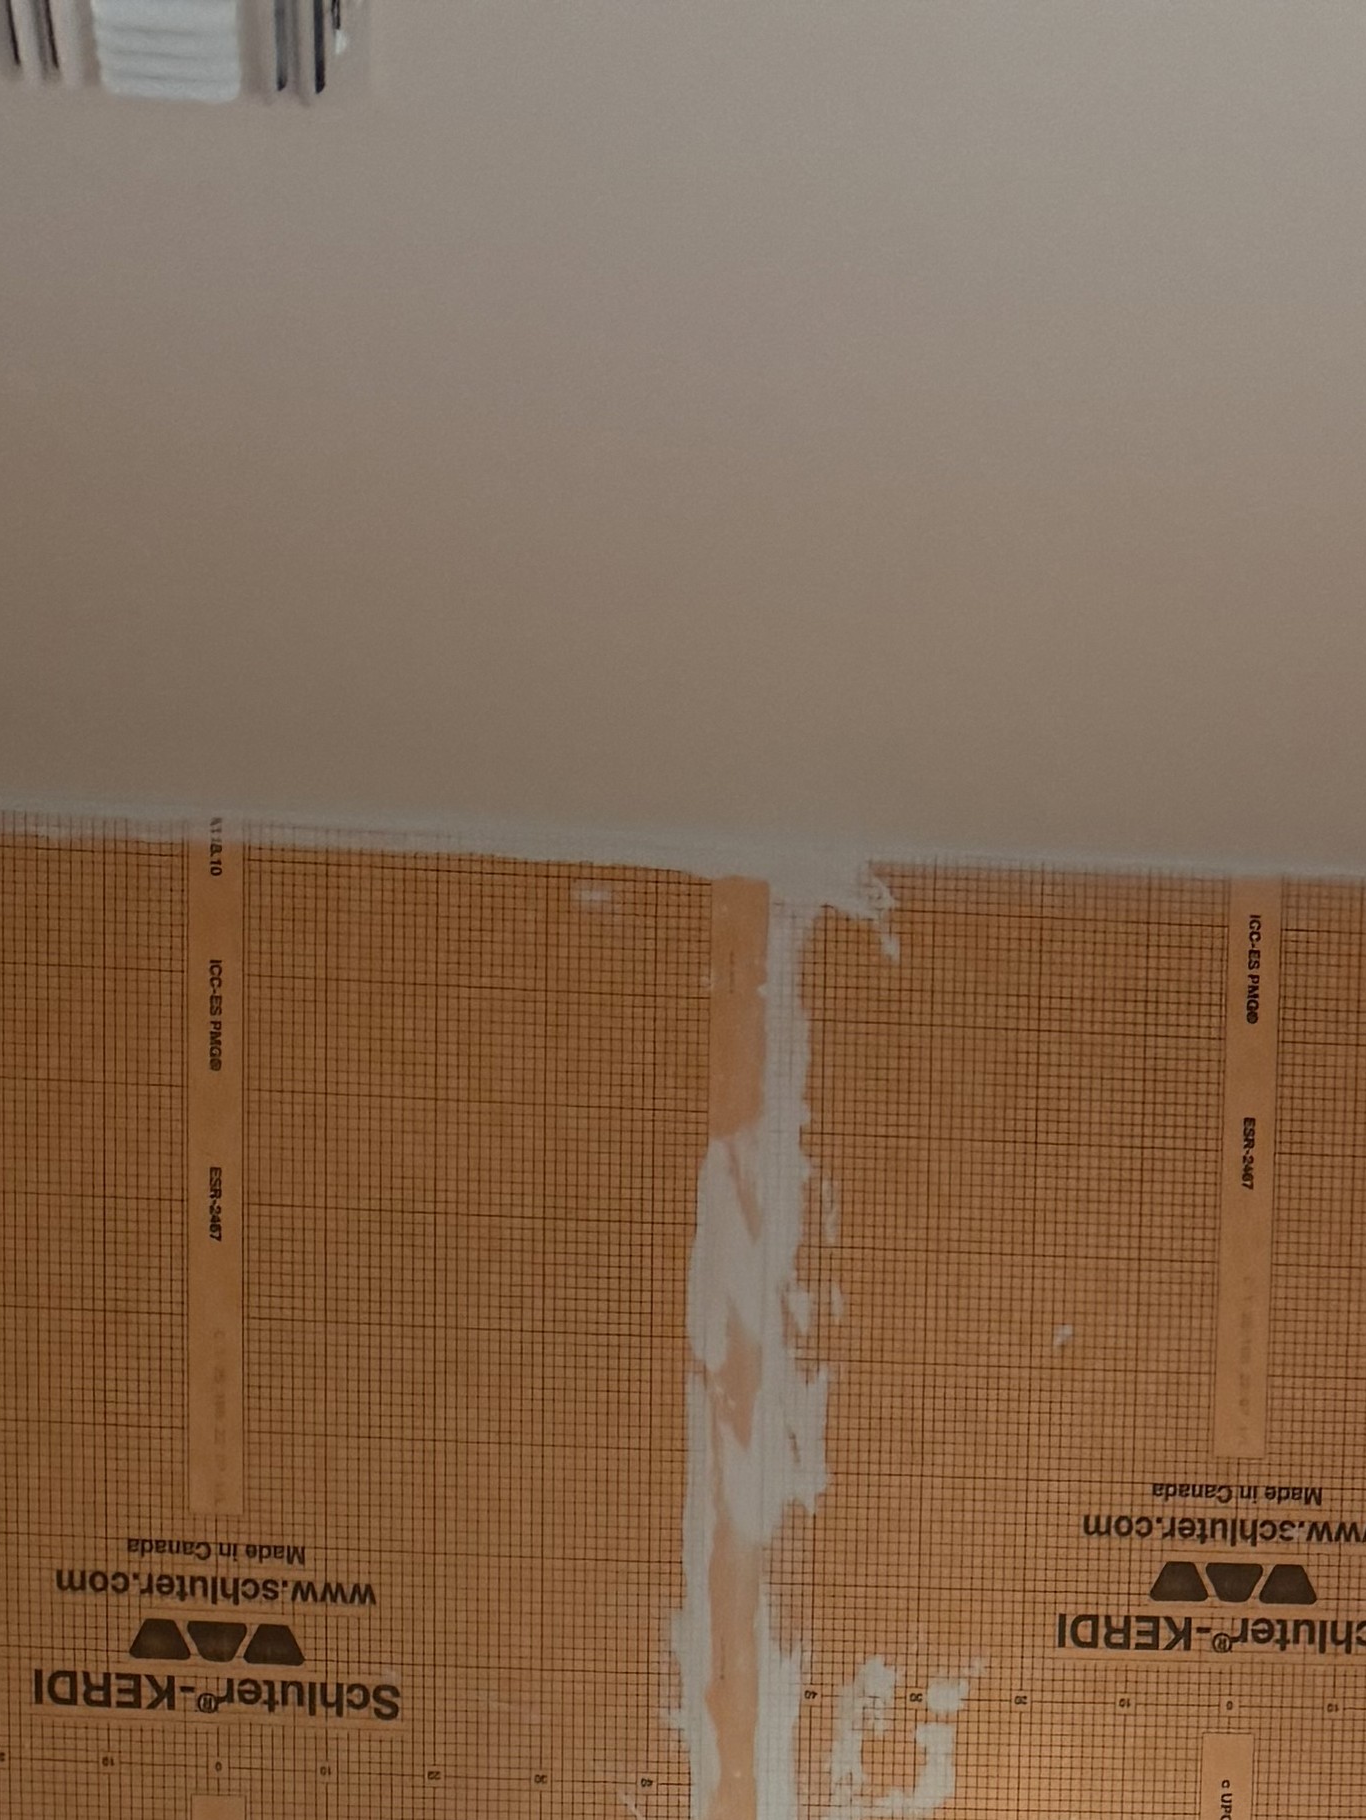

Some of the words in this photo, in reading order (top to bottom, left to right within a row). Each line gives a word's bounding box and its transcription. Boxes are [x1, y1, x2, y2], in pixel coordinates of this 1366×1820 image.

[1152, 1483, 1232, 1503] Canada
[1240, 1486, 1257, 1504] in
[1265, 1487, 1322, 1506] Made
[127, 1539, 211, 1559] Canada
[219, 1543, 237, 1562] in
[246, 1543, 305, 1565] Made
[56, 1570, 376, 1606] www.schluter.com
